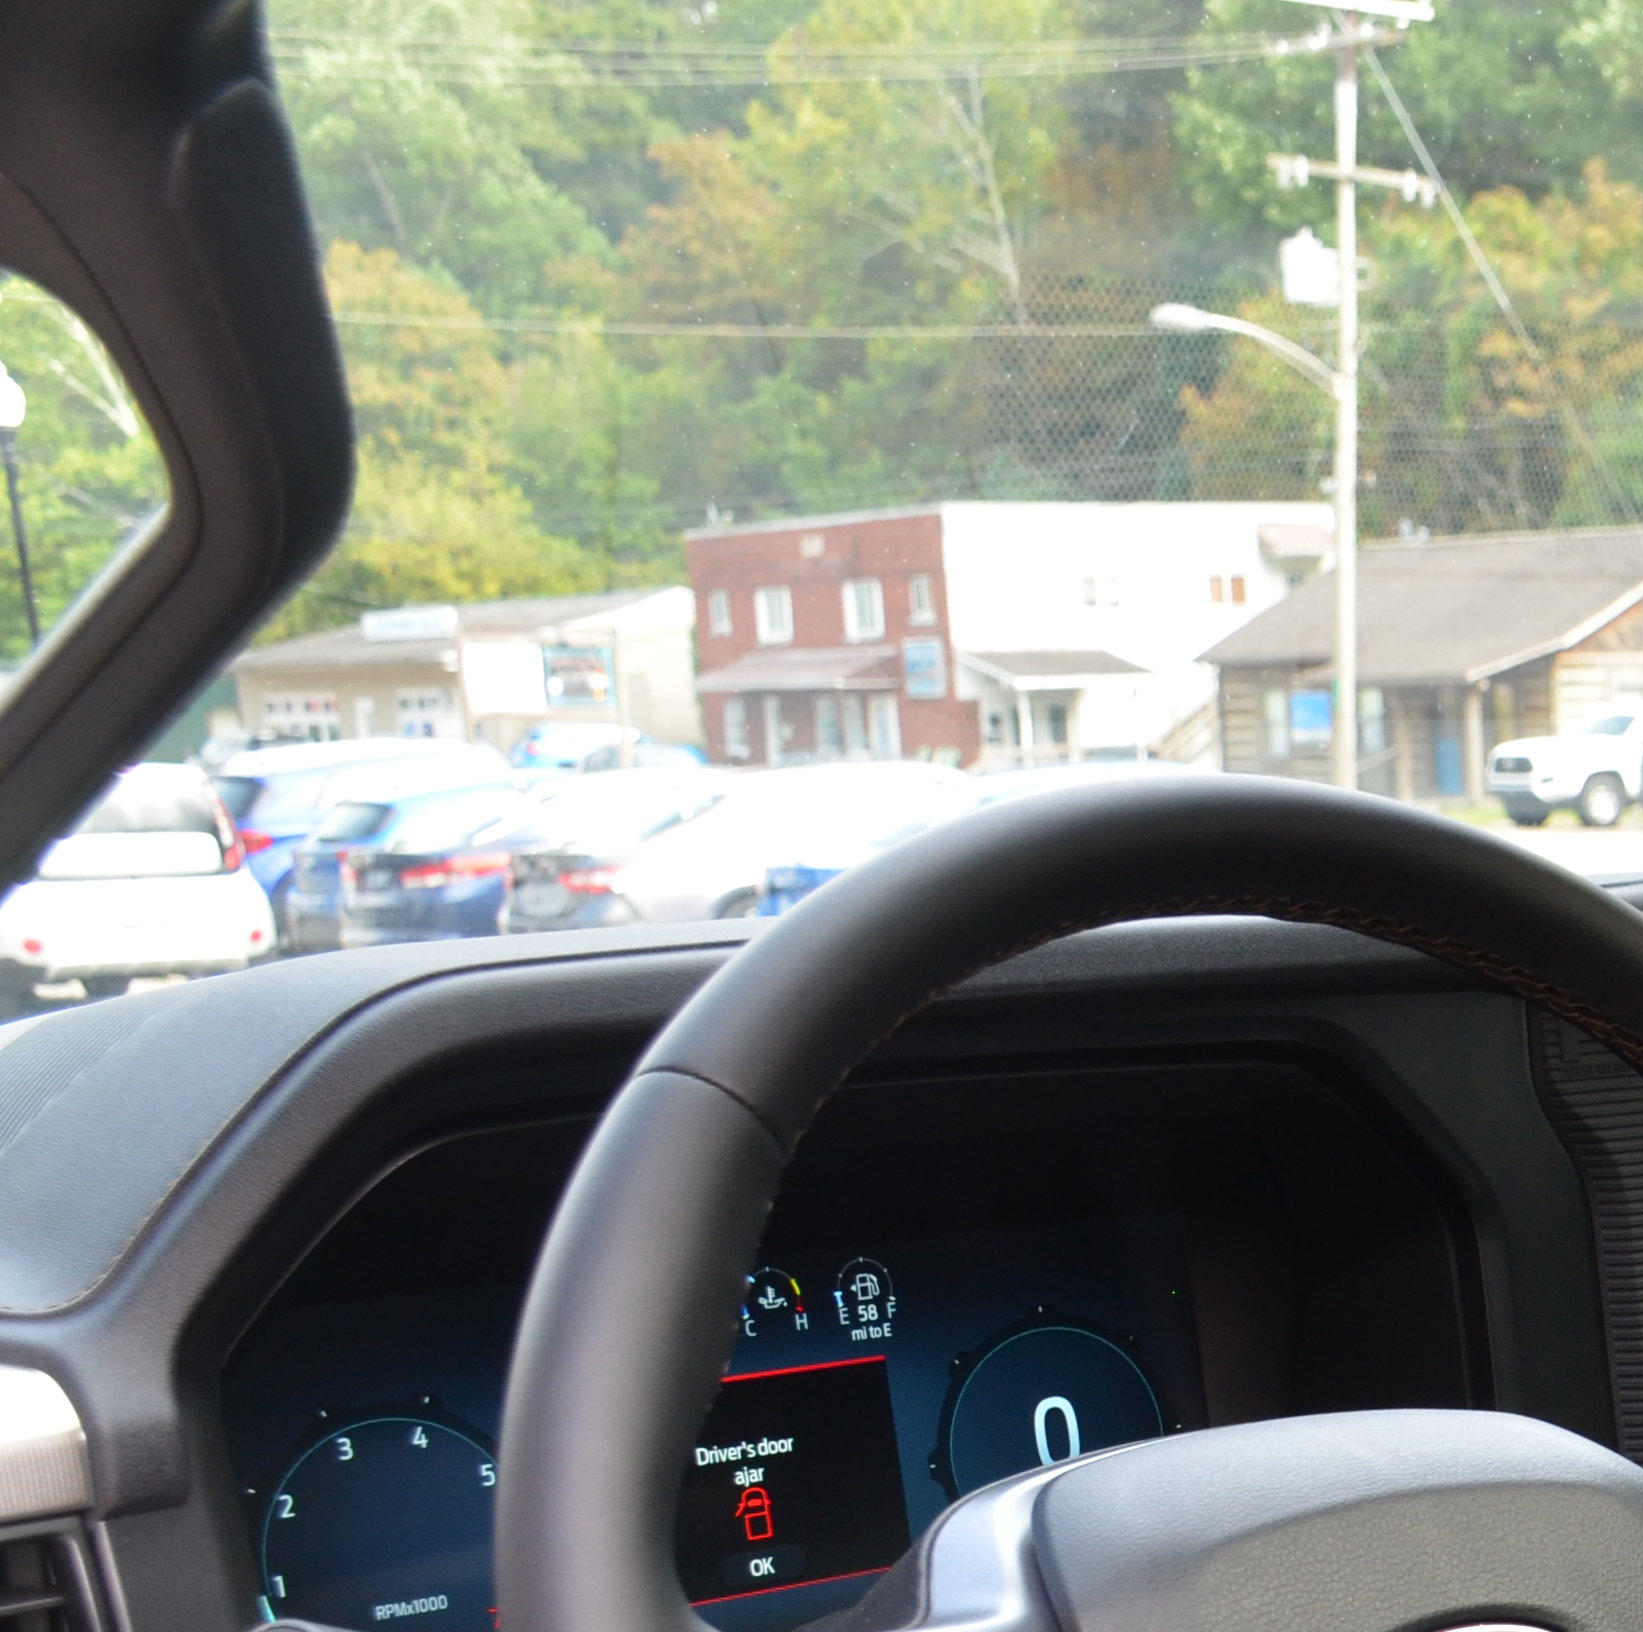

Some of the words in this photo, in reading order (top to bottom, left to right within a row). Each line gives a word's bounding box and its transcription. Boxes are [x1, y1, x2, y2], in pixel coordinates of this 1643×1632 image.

[744, 1319, 757, 1337] C
[795, 1312, 809, 1330] H
[838, 1307, 850, 1325] E
[857, 1304, 878, 1322] 58
[886, 1301, 897, 1319] F
[851, 1326, 868, 1341] mi
[869, 1325, 883, 1339] to
[883, 1322, 893, 1338] E
[410, 1425, 429, 1449] 4
[1033, 1395, 1081, 1467] 0
[335, 1437, 354, 1461] 3
[695, 1441, 756, 1466] Driver's
[757, 1437, 794, 1456] door
[479, 1462, 496, 1487] 5
[733, 1466, 765, 1487] ajar
[278, 1494, 296, 1518] 2
[749, 1556, 776, 1577] OK
[272, 1574, 286, 1599] 1
[373, 1594, 450, 1622] RPMx1000
